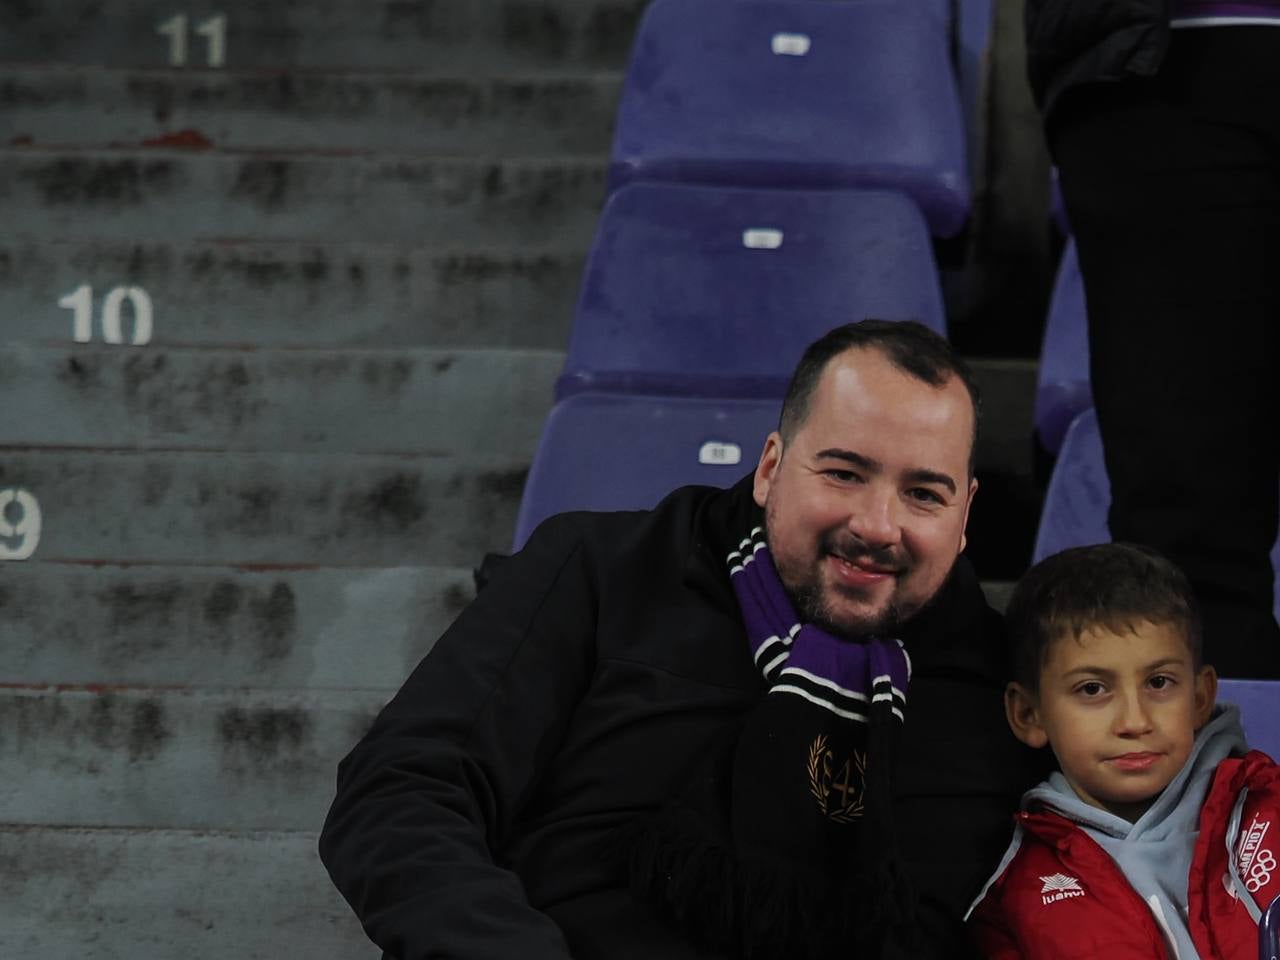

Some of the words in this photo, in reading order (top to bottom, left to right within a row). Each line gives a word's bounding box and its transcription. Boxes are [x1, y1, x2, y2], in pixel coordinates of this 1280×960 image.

[157, 15, 226, 68] 11
[57, 285, 153, 346] 10
[0, 488, 42, 561] 9
[1246, 832, 1261, 850] PIO
[1254, 822, 1266, 830] X
